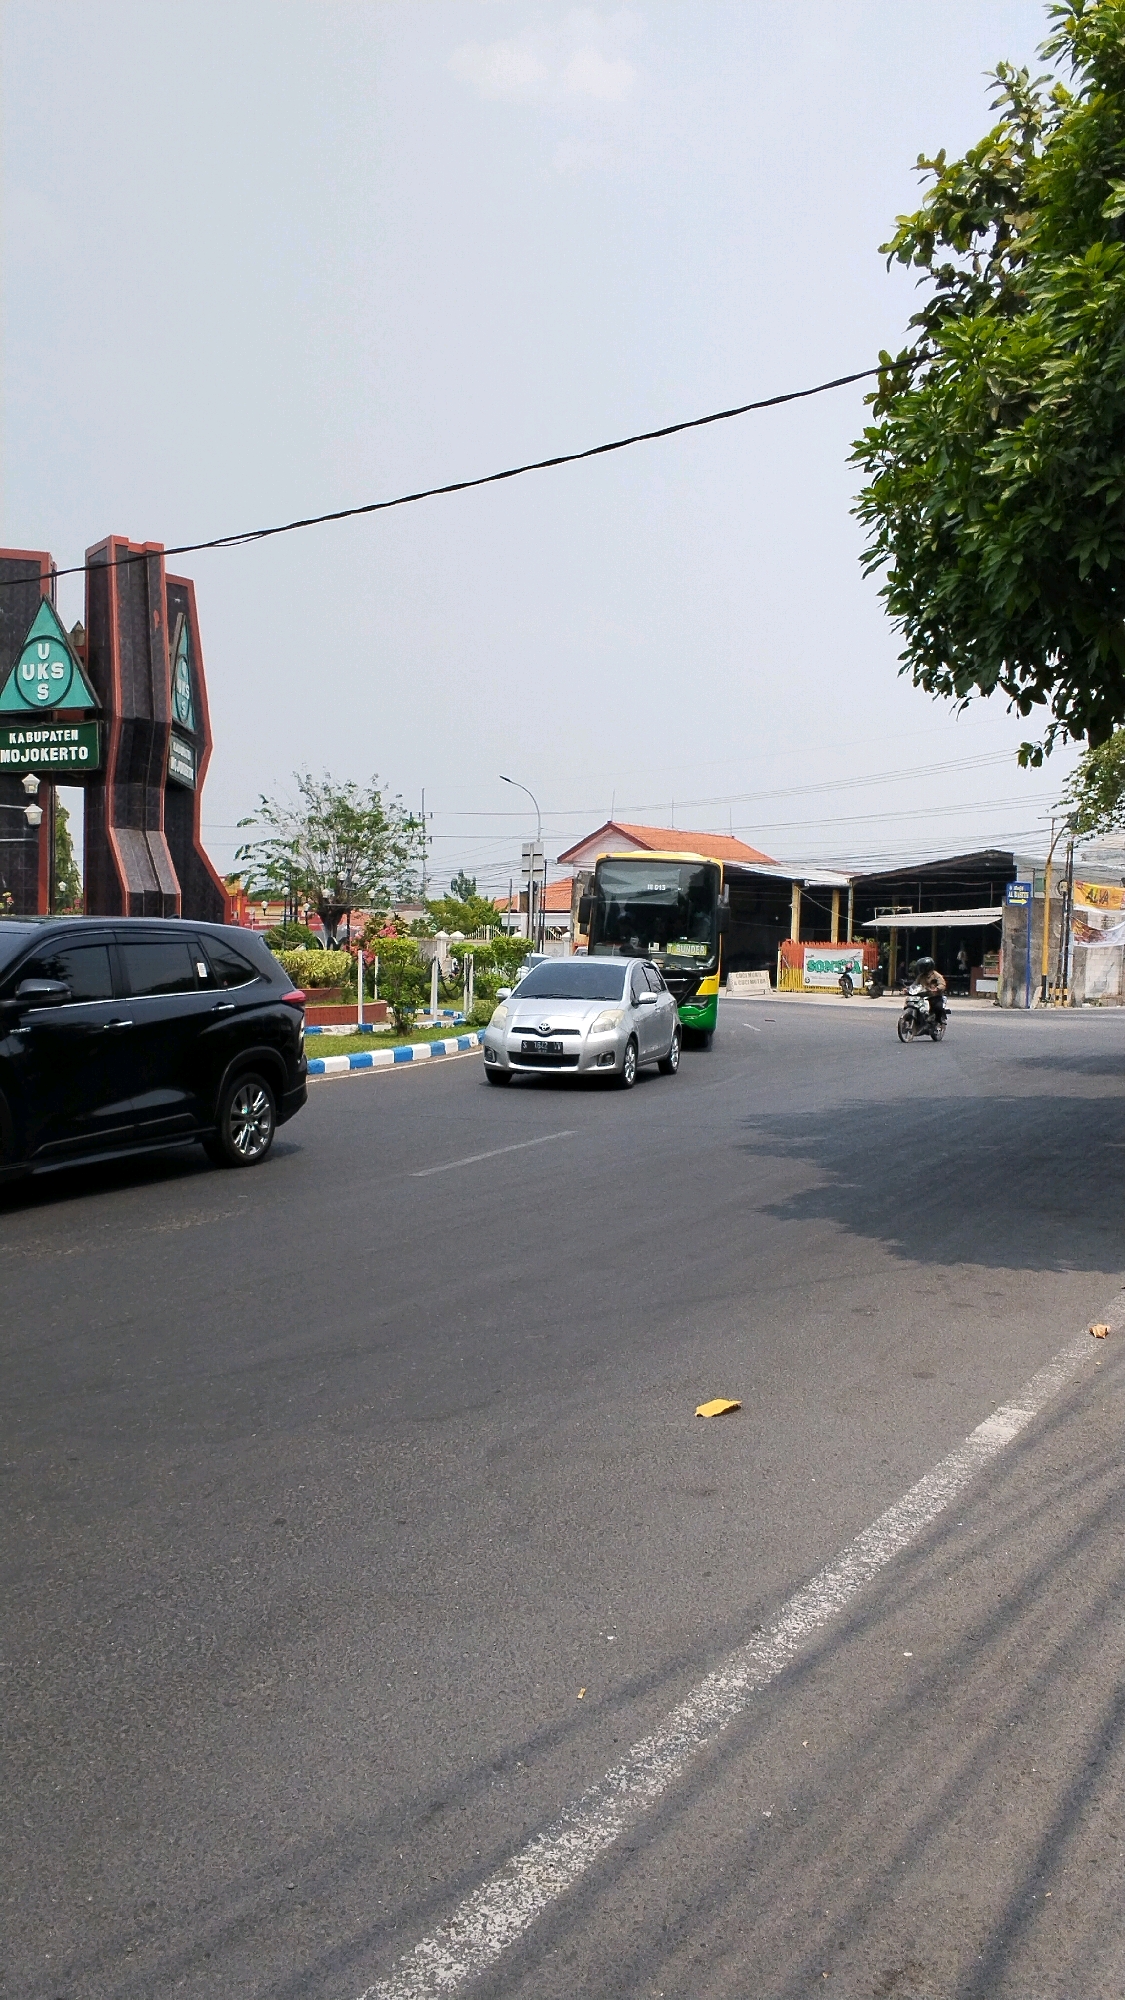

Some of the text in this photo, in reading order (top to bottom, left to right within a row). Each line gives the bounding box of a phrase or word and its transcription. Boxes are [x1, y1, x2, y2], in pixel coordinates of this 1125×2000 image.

[37, 642, 50, 660] U
[22, 662, 64, 681] UKS
[37, 682, 49, 700] S
[9, 729, 79, 744] KABUPATEN
[0, 746, 89, 763] MOJOKERTO
